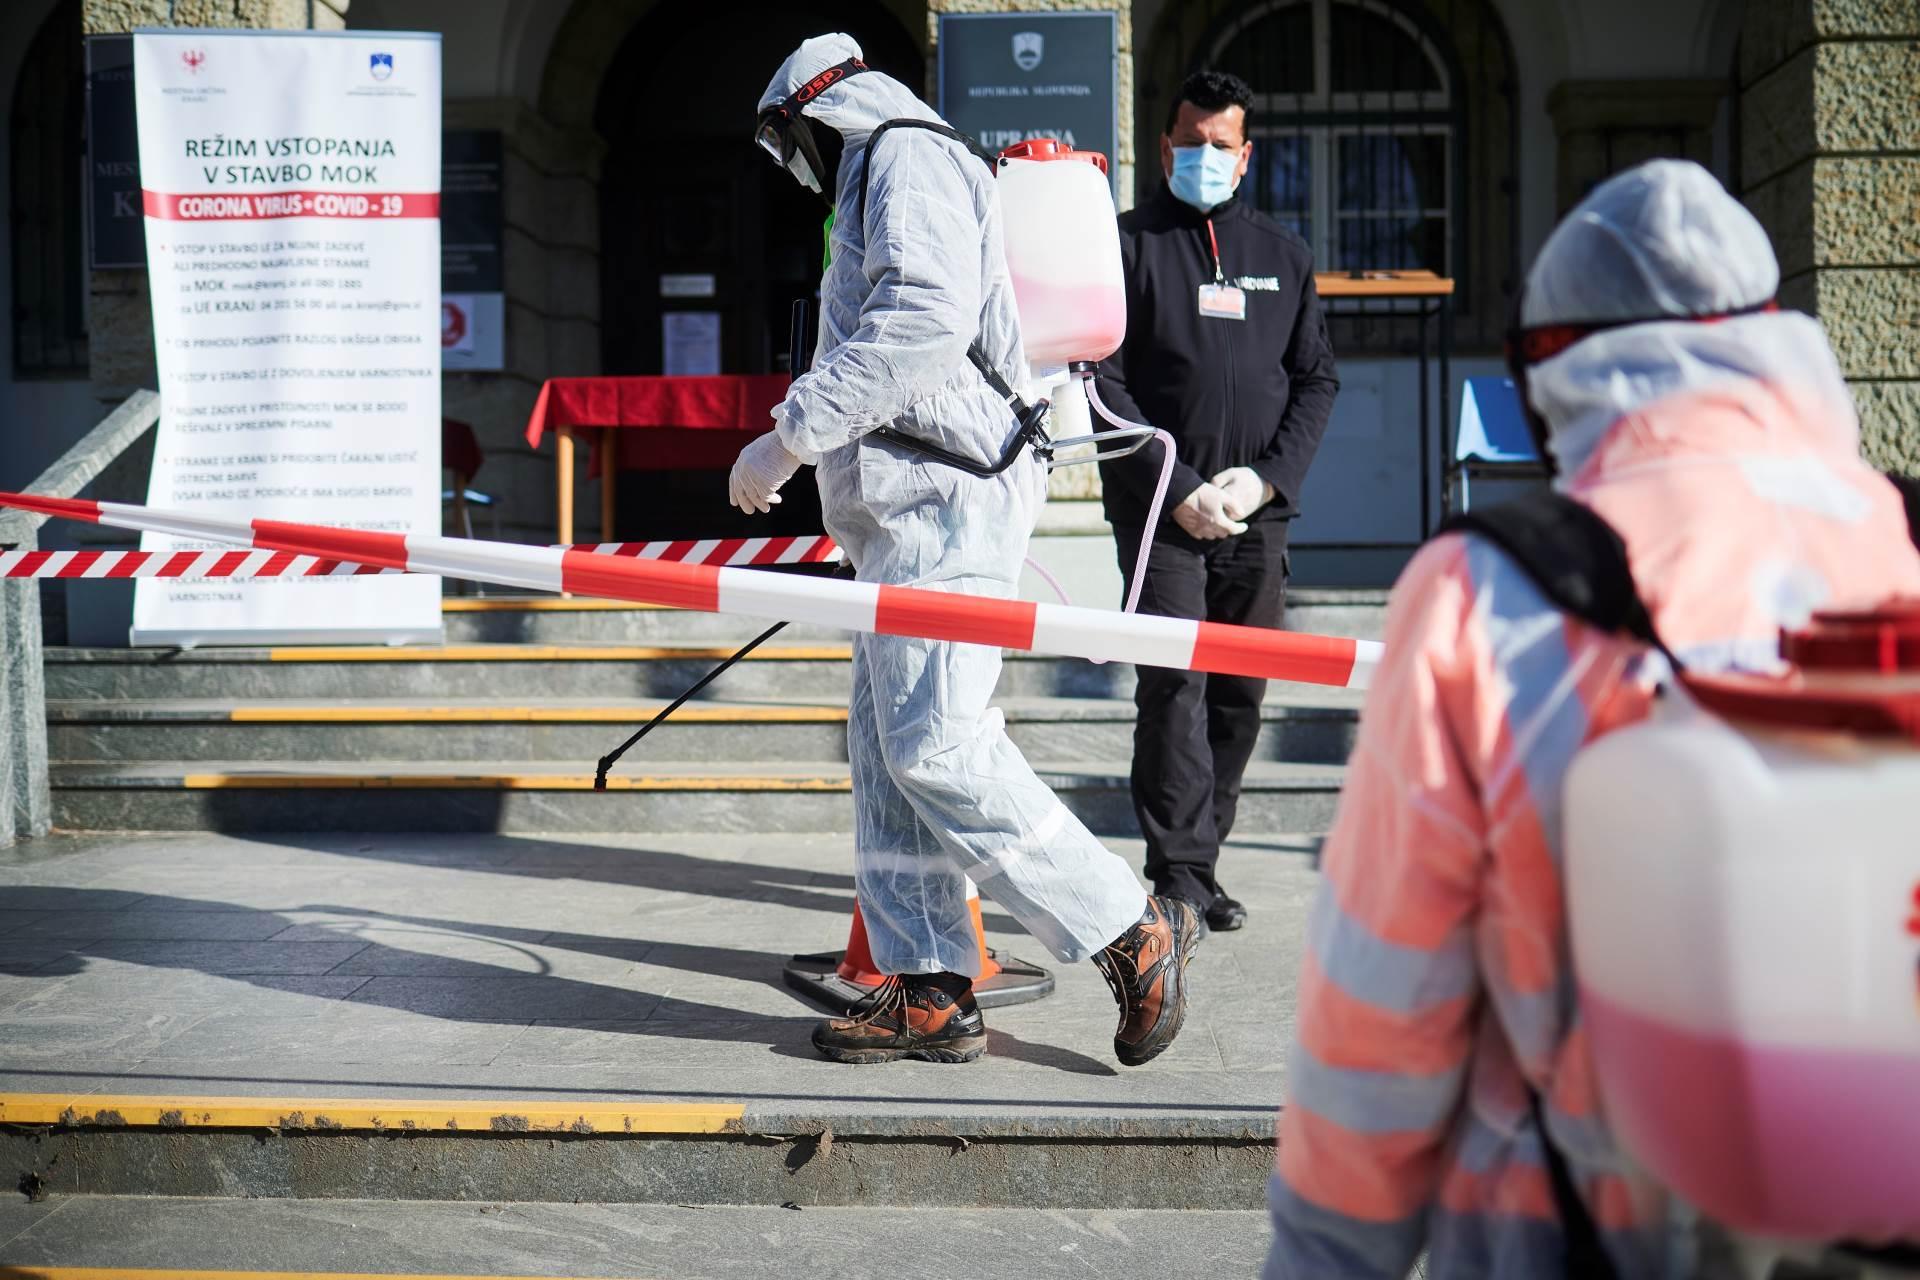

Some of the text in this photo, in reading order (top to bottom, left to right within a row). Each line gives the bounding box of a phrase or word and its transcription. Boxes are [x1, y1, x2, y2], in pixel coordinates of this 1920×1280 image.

[806, 71, 835, 96] JSP
[969, 85, 1091, 97] REPUBLIKA SLOVENIJA
[185, 134, 395, 157] REŽIM VSTOPANJA
[203, 164, 377, 184] V STAVBO MOK
[178, 197, 252, 217] CORONA
[219, 243, 258, 253] STAVBO
[192, 261, 257, 271] PREDHODNO
[194, 302, 209, 313] UE
[216, 301, 255, 312] KRANJ
